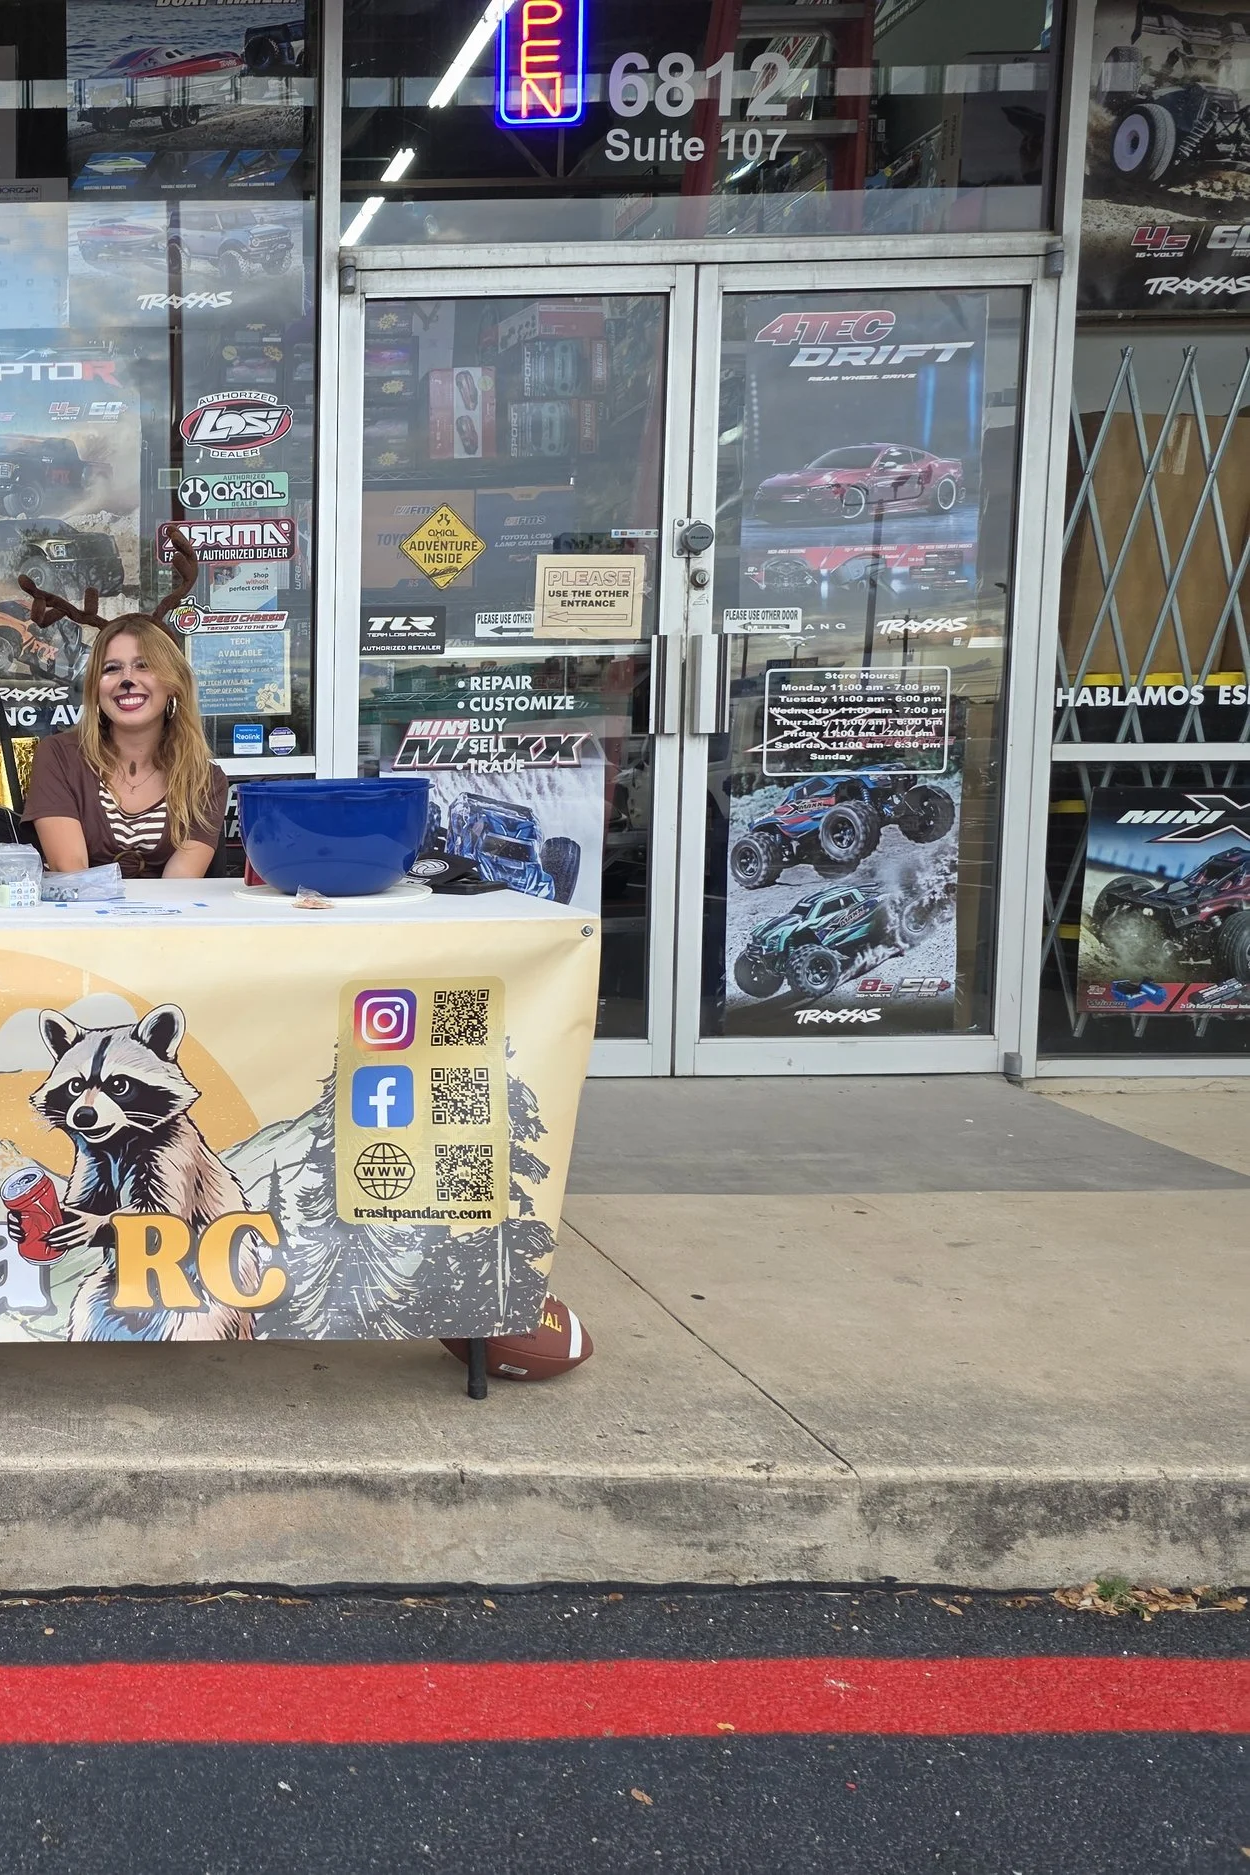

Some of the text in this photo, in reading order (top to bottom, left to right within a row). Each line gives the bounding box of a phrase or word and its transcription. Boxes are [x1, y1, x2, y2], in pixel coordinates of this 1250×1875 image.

[609, 52, 788, 118] 6812
[605, 129, 788, 162] Suite 107
[136, 291, 233, 311] TRAXXAS
[755, 310, 896, 346] 4TEC
[789, 341, 975, 368] DRIFT
[199, 392, 277, 405] AUTHORIZED
[211, 448, 259, 458] DEALER
[223, 473, 266, 481] AUTHORIZED
[409, 540, 478, 552] ADVENTURE
[202, 549, 254, 561] AUTHORIZED
[256, 548, 288, 559] DEALER
[423, 553, 463, 564] INSIDE
[547, 570, 632, 586] PLEASE
[560, 600, 616, 608] ENTRANCE
[202, 614, 237, 624] SPEED
[477, 613, 532, 624] PLEASE USE OTHER
[725, 610, 798, 621] PLEASE USE OTHER DOOR
[368, 617, 435, 631] TLR
[876, 616, 969, 635] TRAXXAS
[230, 637, 250, 645] TECH
[218, 649, 263, 657] AVAILABLE
[824, 672, 899, 680] Store Hours:
[470, 675, 533, 691] REPAIR
[781, 683, 827, 692] Monday
[830, 683, 862, 691] 11:00
[894, 683, 919, 691] 7:00
[922, 684, 941, 693] pm
[779, 695, 828, 704] Tuesday
[831, 695, 863, 703] 11:00
[895, 695, 920, 703] 6:00
[923, 696, 942, 704] pm
[1056, 685, 1250, 707] HABLAMOS ES
[469, 695, 575, 711] CUSTOMIZE
[769, 706, 836, 715] Wednesday
[903, 706, 928, 714] 7:00
[930, 707, 947, 716] pm
[469, 717, 507, 732] BUY
[774, 718, 830, 727] Thursday
[924, 719, 943, 728] pm
[783, 730, 823, 739] Friday
[825, 730, 855, 738] 11:00
[887, 730, 911, 738] 7:00
[915, 731, 933, 739] pm
[469, 739, 507, 754] SELL
[774, 741, 828, 750] Saturday
[830, 741, 863, 749] 11:00
[894, 741, 919, 749] 6:30
[923, 742, 941, 751] pm
[810, 753, 854, 762] Sunday
[469, 758, 526, 774] TRADE
[1116, 810, 1226, 824] MINI
[794, 1007, 882, 1025] TRAXXAS
[362, 1166, 406, 1177] WWW
[353, 1206, 492, 1222] trashpandarc.com
[111, 1212, 290, 1312] RC
